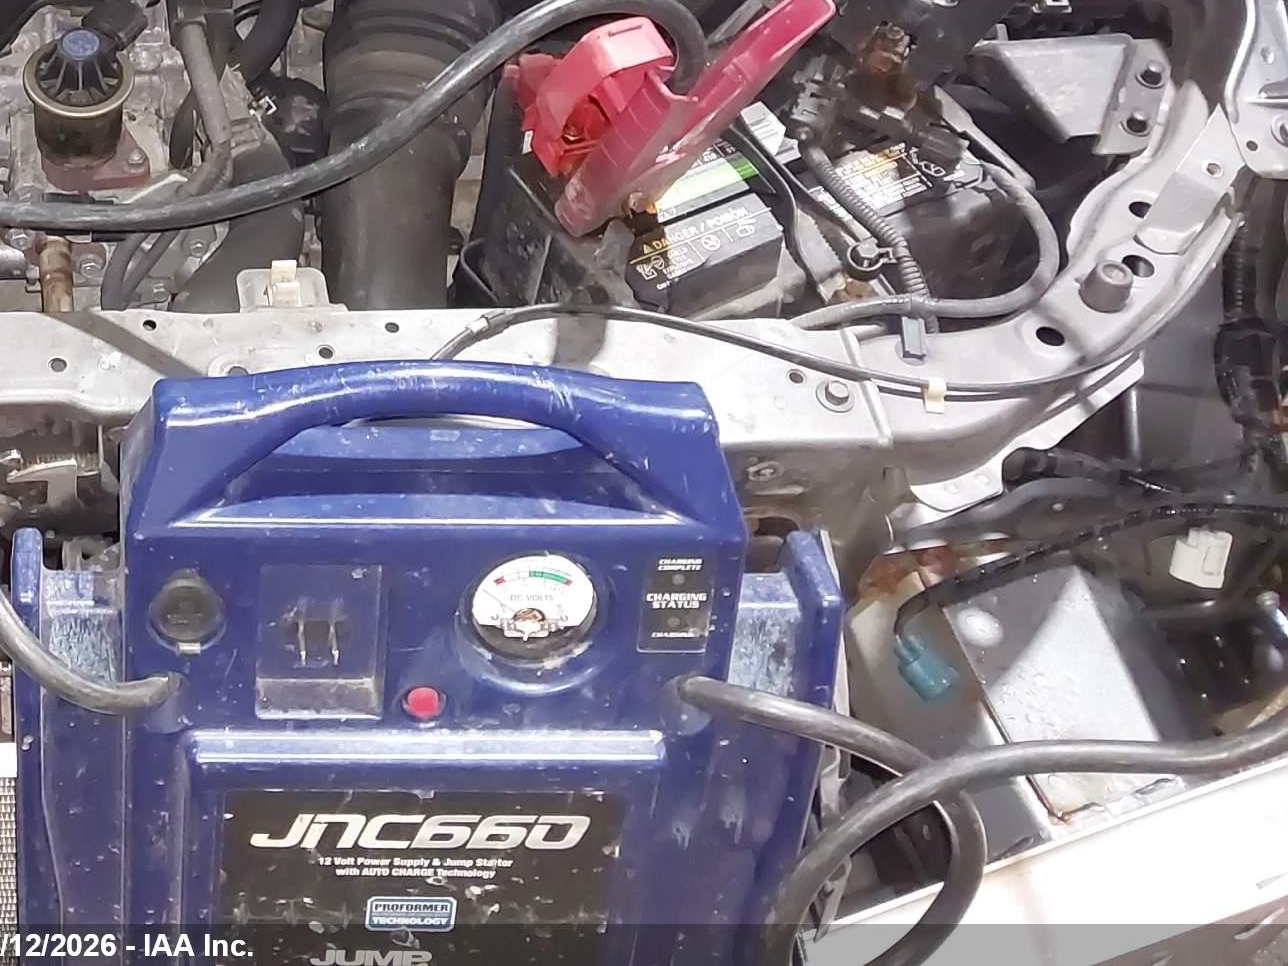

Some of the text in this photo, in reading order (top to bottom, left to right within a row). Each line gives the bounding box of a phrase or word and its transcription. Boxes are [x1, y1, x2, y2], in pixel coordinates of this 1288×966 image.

[652, 226, 699, 250] DANGER
[658, 558, 703, 566] CHARGING
[527, 594, 554, 602] VOLTS
[646, 592, 708, 602] CHARGING
[652, 601, 700, 609] STATUS
[318, 856, 513, 868] 12 Volt Power Supply & Jump Starter
[335, 867, 496, 879] with AUTO CHARGE Technology
[374, 903, 449, 913] PROFORMER
[372, 917, 449, 926] TECHNOLOGY
[309, 949, 433, 966] JUMP
